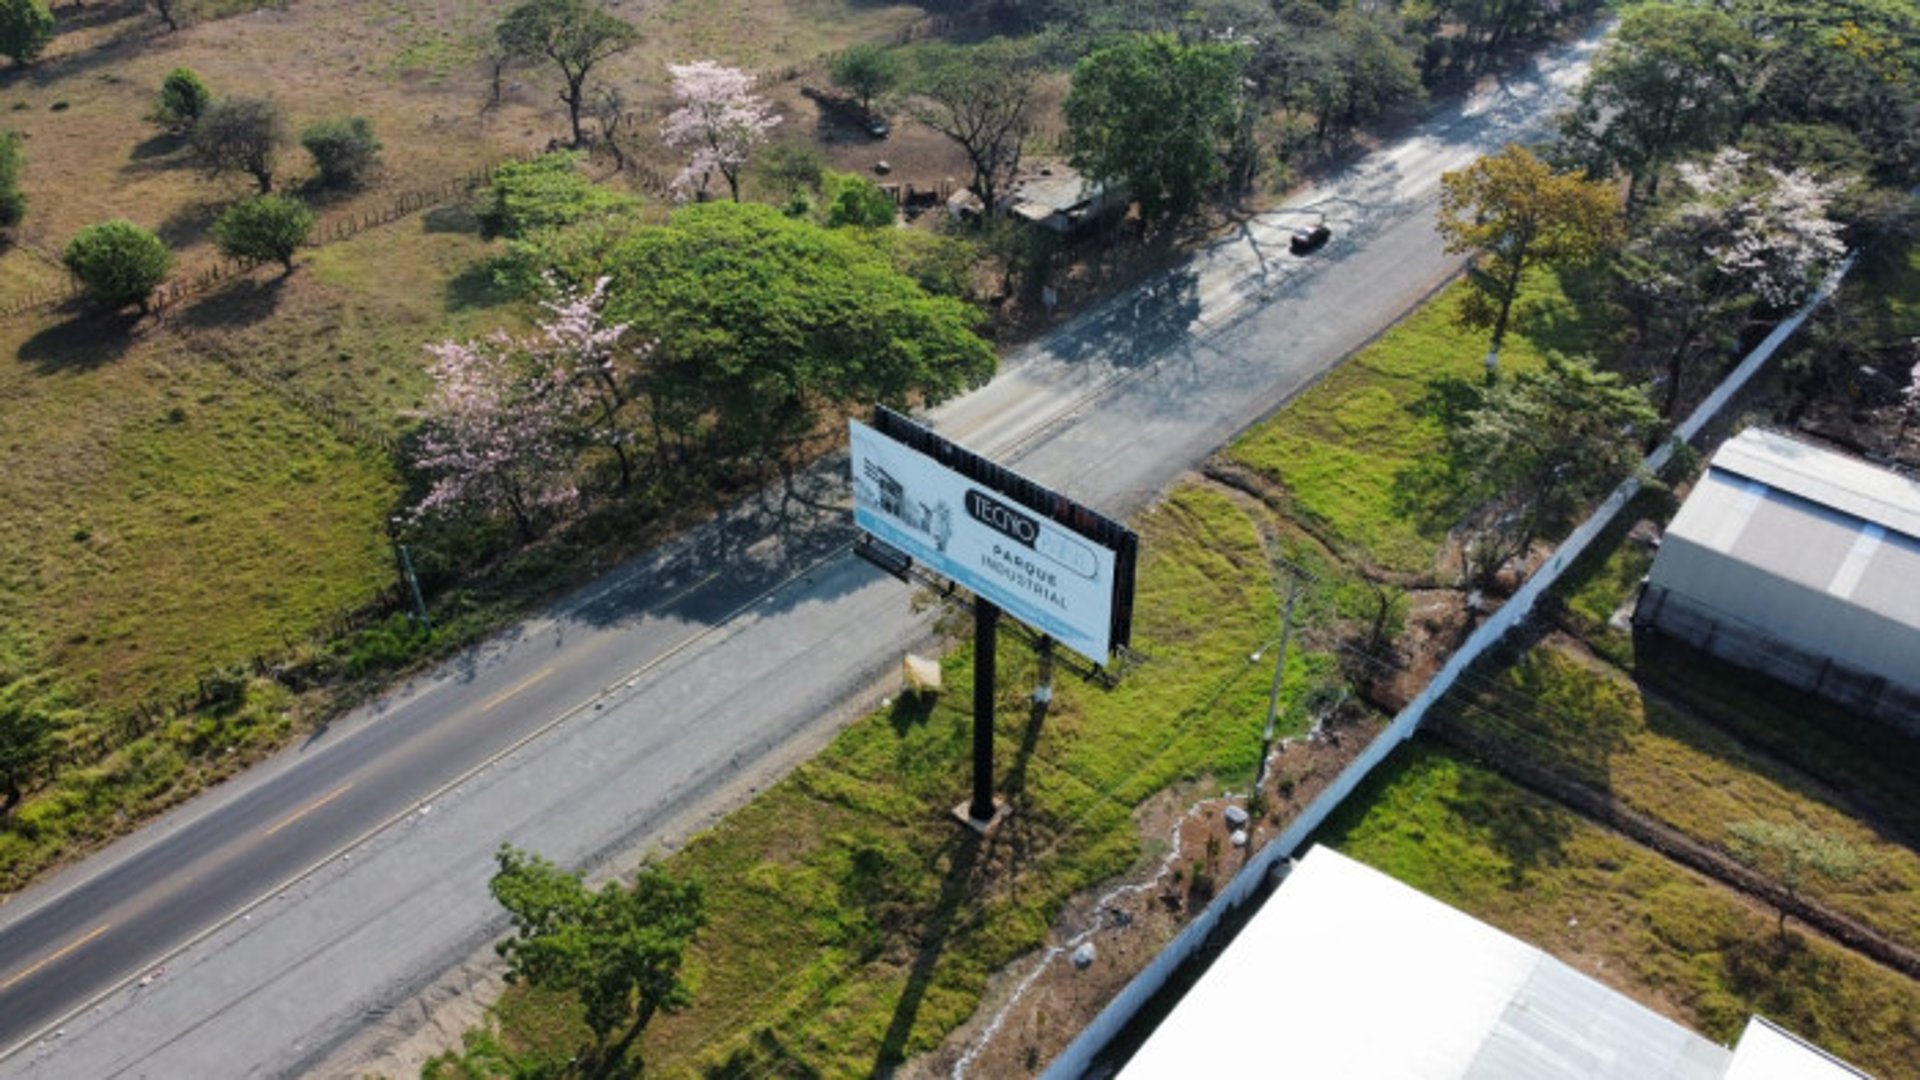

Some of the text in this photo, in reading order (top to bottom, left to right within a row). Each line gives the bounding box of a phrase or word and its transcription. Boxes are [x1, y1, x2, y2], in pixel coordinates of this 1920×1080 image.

[974, 495, 1034, 541] TECNO
[981, 554, 1068, 609] INDUSTRIAL
[992, 545, 1057, 587] PARQUE
